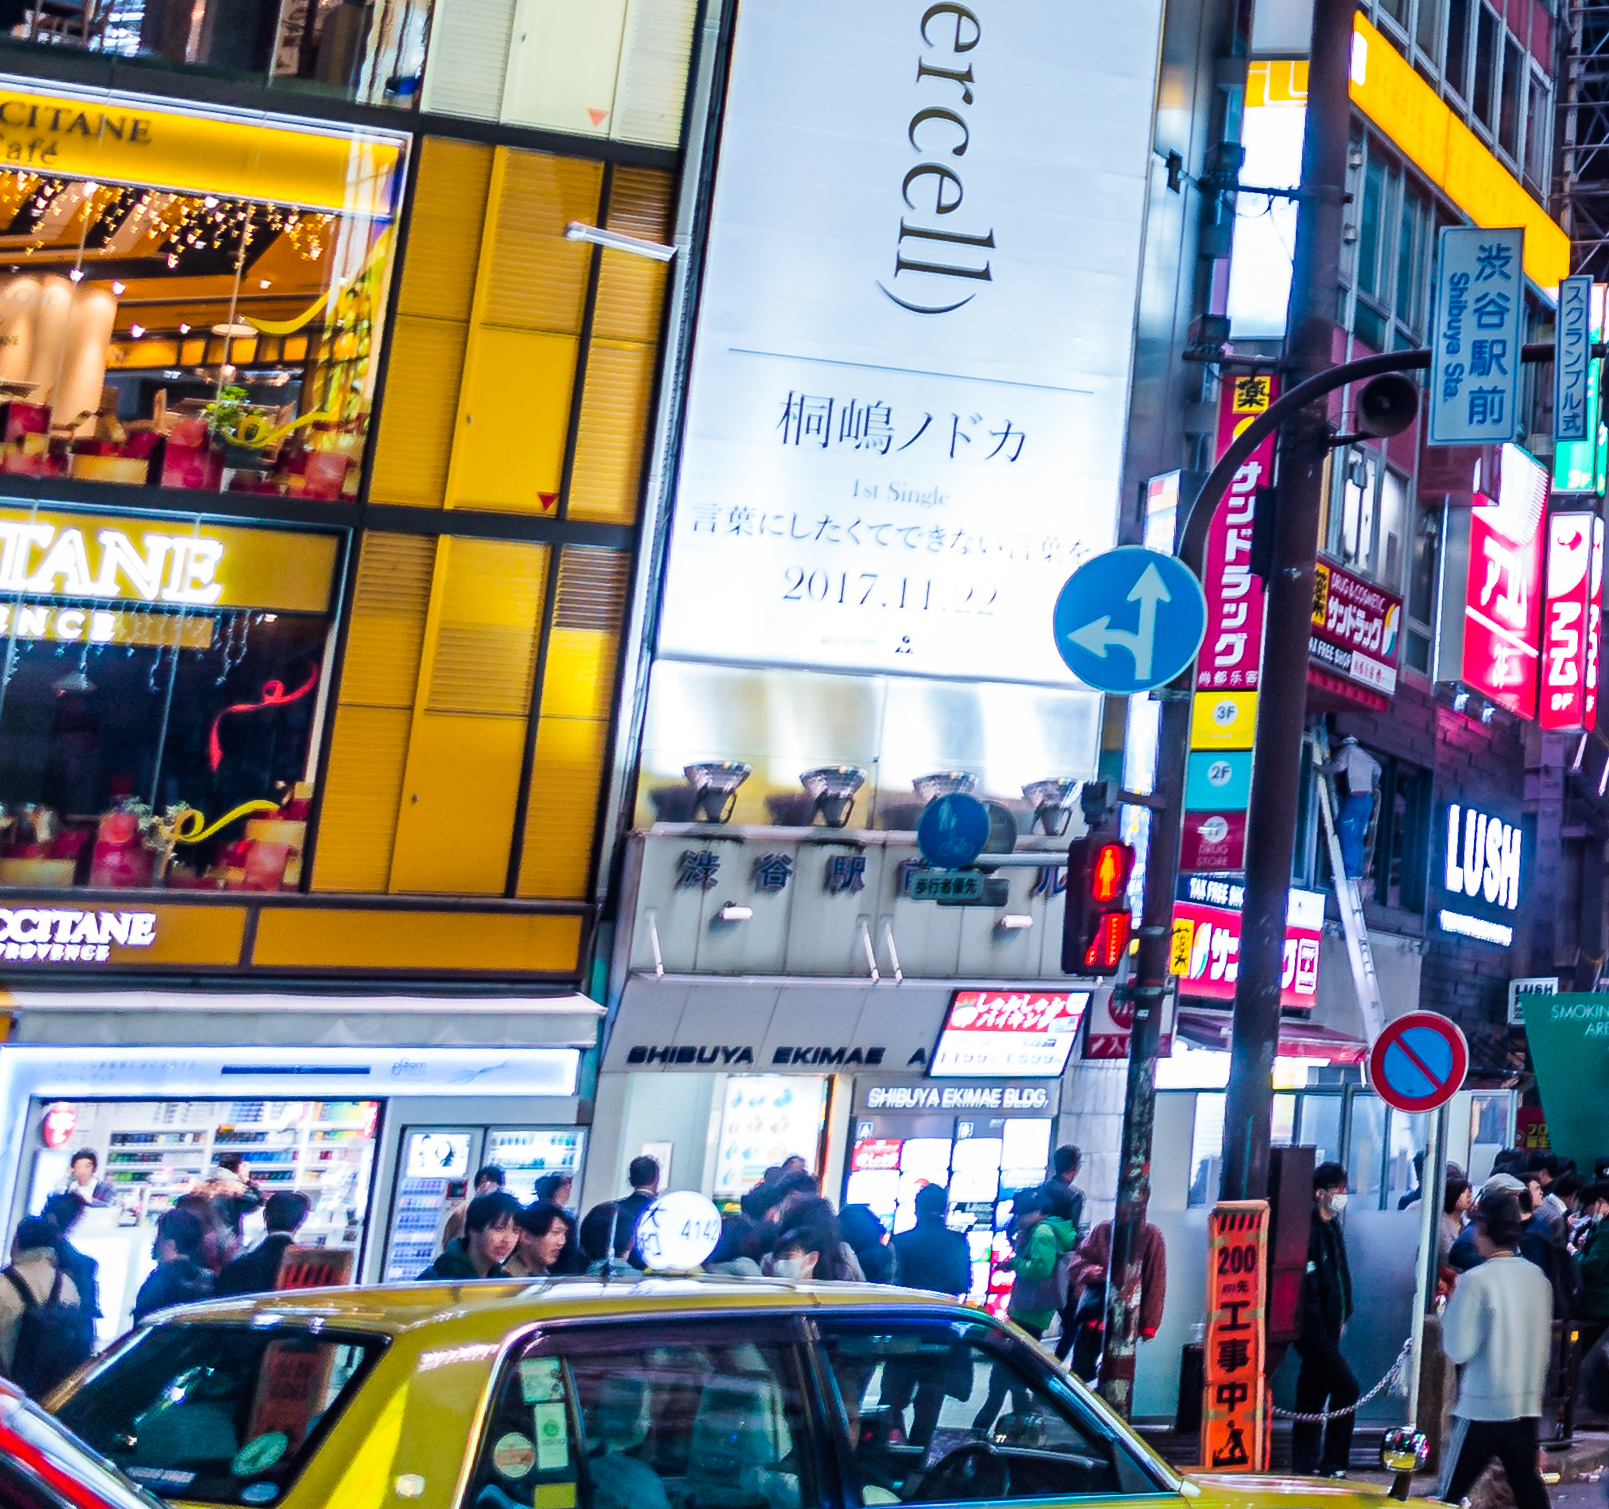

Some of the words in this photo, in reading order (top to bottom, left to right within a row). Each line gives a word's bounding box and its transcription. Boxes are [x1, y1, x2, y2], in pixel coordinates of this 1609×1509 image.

[1446, 271, 1470, 359] Shibuya
[1468, 243, 1513, 426] 渋谷駅前
[1561, 284, 1582, 433] スクランブル式
[777, 389, 1026, 463] 桐嶋ノドカ
[1237, 378, 1270, 412] 薬
[851, 479, 881, 501] 1st
[886, 482, 951, 509] Single
[1214, 461, 1262, 668] サンドラッグ
[1327, 596, 1383, 651] サンドラッグ
[1549, 602, 1581, 686] アコム
[1217, 706, 1235, 719] 3F
[1211, 767, 1230, 780] 2F
[1446, 804, 1522, 910] LUSH
[626, 1045, 754, 1066] SHIBUYA
[771, 1047, 886, 1066] EKIMAE
[868, 1087, 939, 1108] SHIBUYA
[941, 1087, 1003, 1108] EKIMAE
[1218, 1245, 1256, 1275] 200
[1217, 1301, 1251, 1412] 工事中
